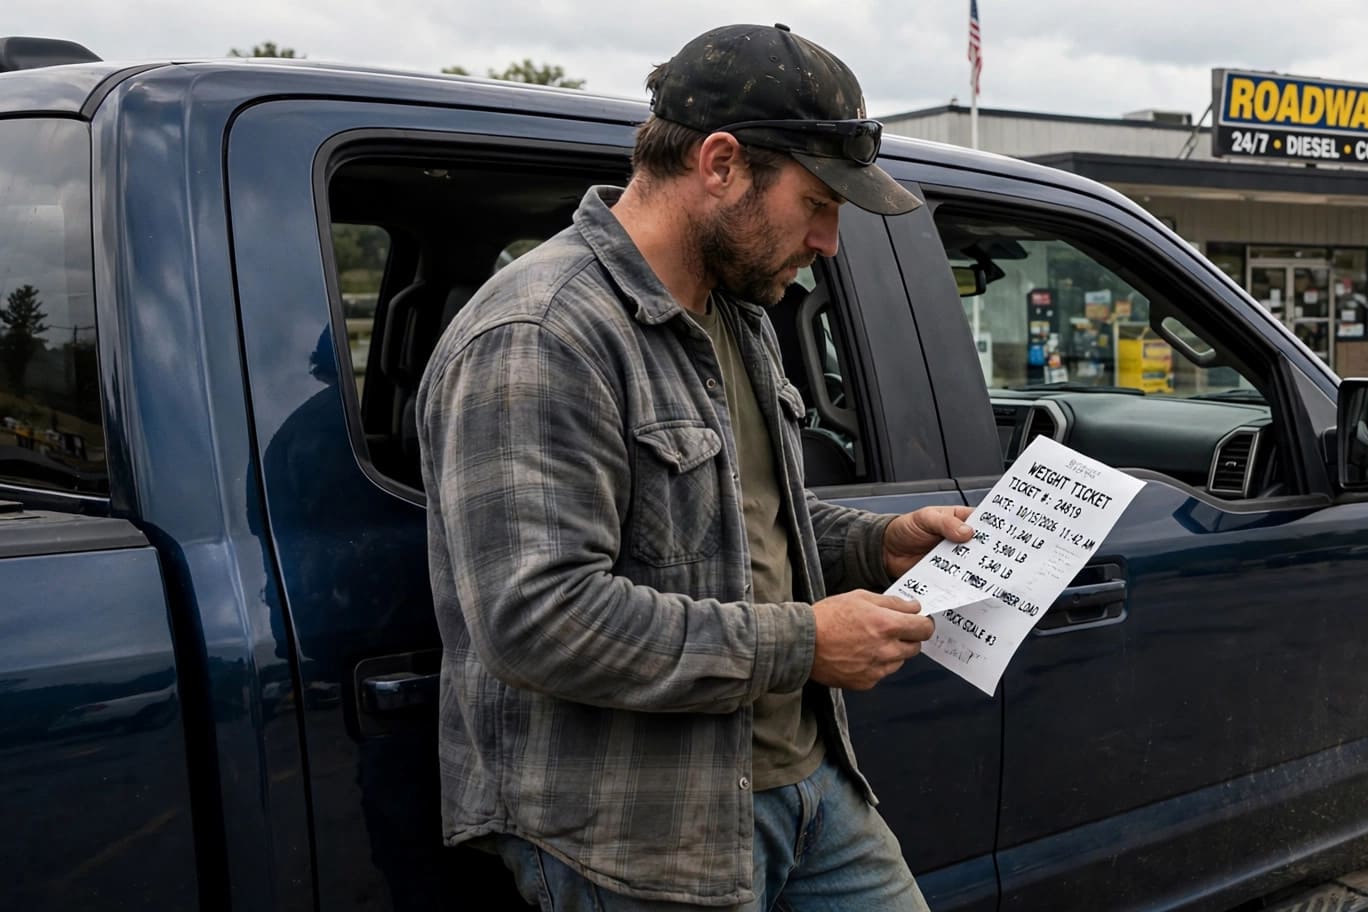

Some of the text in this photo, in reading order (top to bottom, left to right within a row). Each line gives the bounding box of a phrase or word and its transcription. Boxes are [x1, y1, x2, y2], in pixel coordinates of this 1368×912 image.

[1232, 131, 1269, 154] 24/7
[1286, 135, 1339, 159] DIESEL
[1008, 476, 1042, 499] TICKET
[1054, 498, 1082, 519] 24819
[1028, 461, 1071, 490] WEIGHT
[1070, 481, 1113, 509] TICKET
[992, 494, 1015, 512] DATE:
[1059, 527, 1083, 546] 11:42
[1082, 538, 1096, 551] AM
[1014, 551, 1028, 563] LB
[1031, 537, 1045, 549] LB
[1000, 567, 1013, 579] LB
[992, 586, 1020, 607] LUMBER
[1018, 600, 1040, 617] LOAD
[962, 619, 986, 639] SCALE
